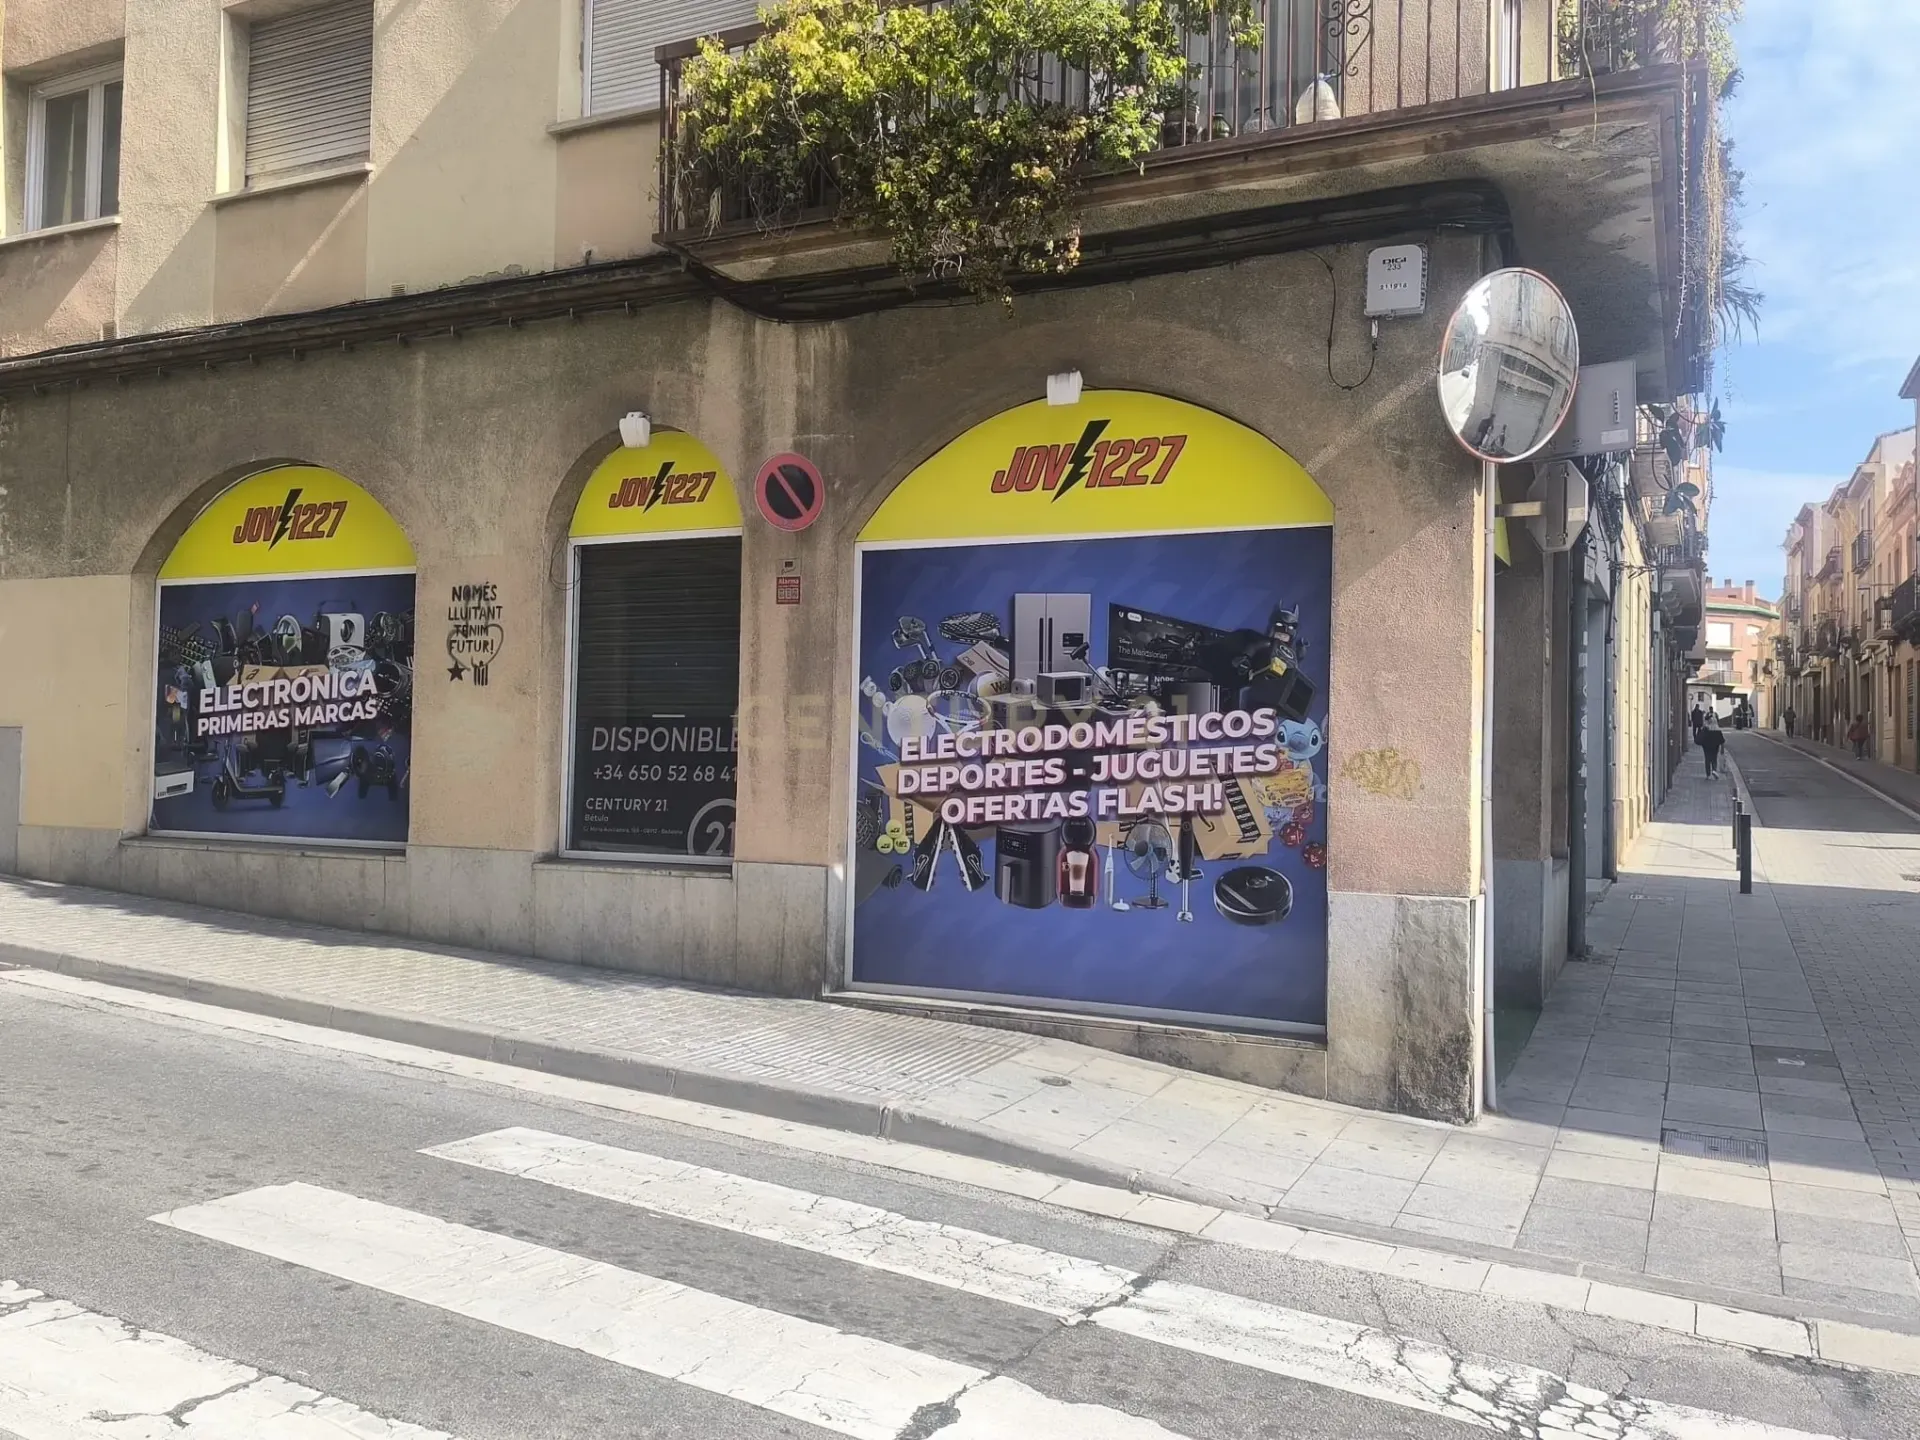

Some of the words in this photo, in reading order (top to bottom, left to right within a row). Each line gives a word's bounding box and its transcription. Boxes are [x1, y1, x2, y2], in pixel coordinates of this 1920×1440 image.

[451, 581, 498, 602] NOMÉS
[448, 605, 503, 621] LLUITANT
[449, 639, 494, 655] FUTUR!
[200, 668, 378, 714] ELECTRÓNICA
[197, 708, 290, 737] PRIMERAS
[295, 699, 378, 727] MARCAS
[900, 707, 1276, 762] ELECTRODOMÉSTICOS
[593, 764, 624, 781] +34
[628, 765, 662, 781] 650
[667, 765, 688, 781] 52
[693, 765, 715, 782] 68
[897, 756, 1066, 795] DEPORTES
[1090, 743, 1279, 783] JUGUETES
[585, 797, 652, 812] CENTURY
[941, 790, 1090, 824] OFERTAS
[1098, 782, 1223, 817] FLASH!
